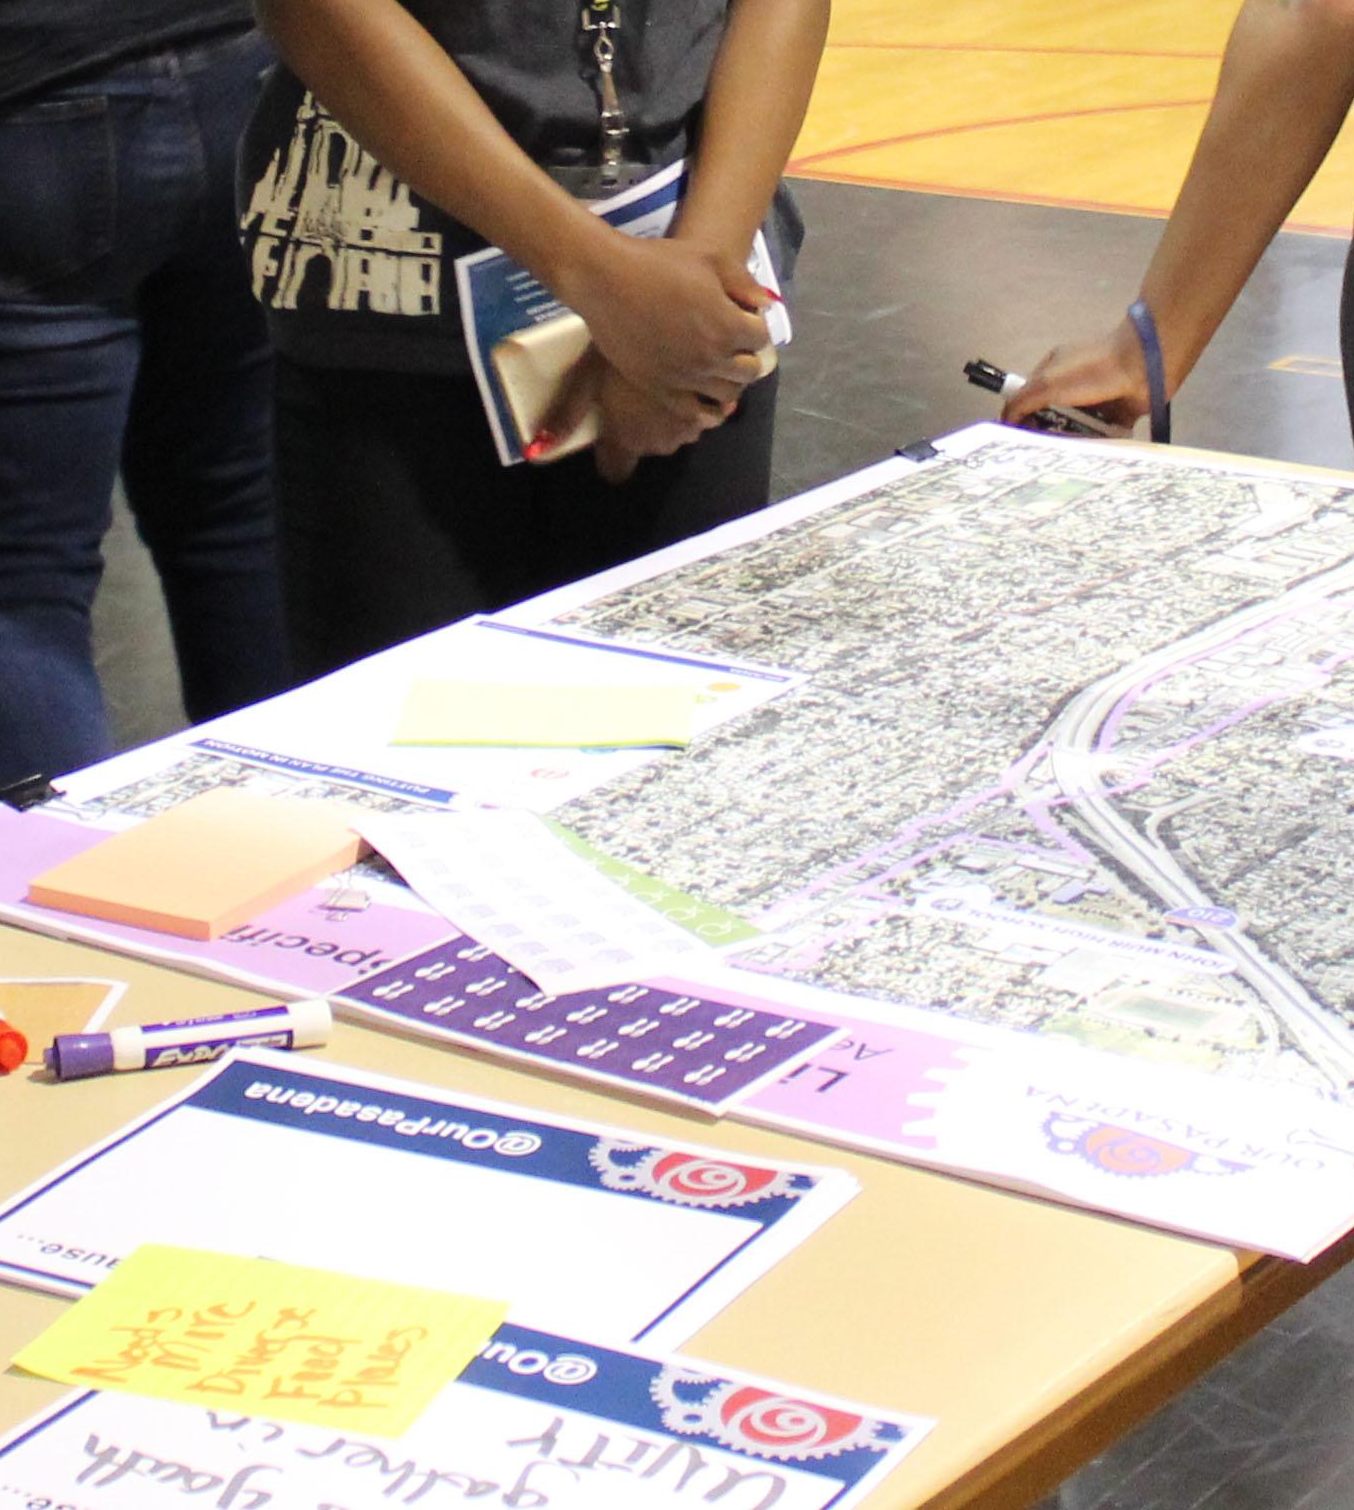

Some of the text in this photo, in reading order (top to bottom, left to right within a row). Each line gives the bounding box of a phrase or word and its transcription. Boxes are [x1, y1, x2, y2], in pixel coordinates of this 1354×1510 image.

[203, 738, 432, 795] PUTTING THE PLAN IN MOTION
[1052, 925, 1106, 945] HIGH
[1108, 938, 1166, 957] MUIR
[1167, 949, 1226, 973] JOHN
[776, 1063, 851, 1095] Li
[243, 1080, 542, 1159] @OurPasadena
[1023, 1083, 1327, 1172] OUR PASADENA
[297, 1434, 579, 1510] gather
